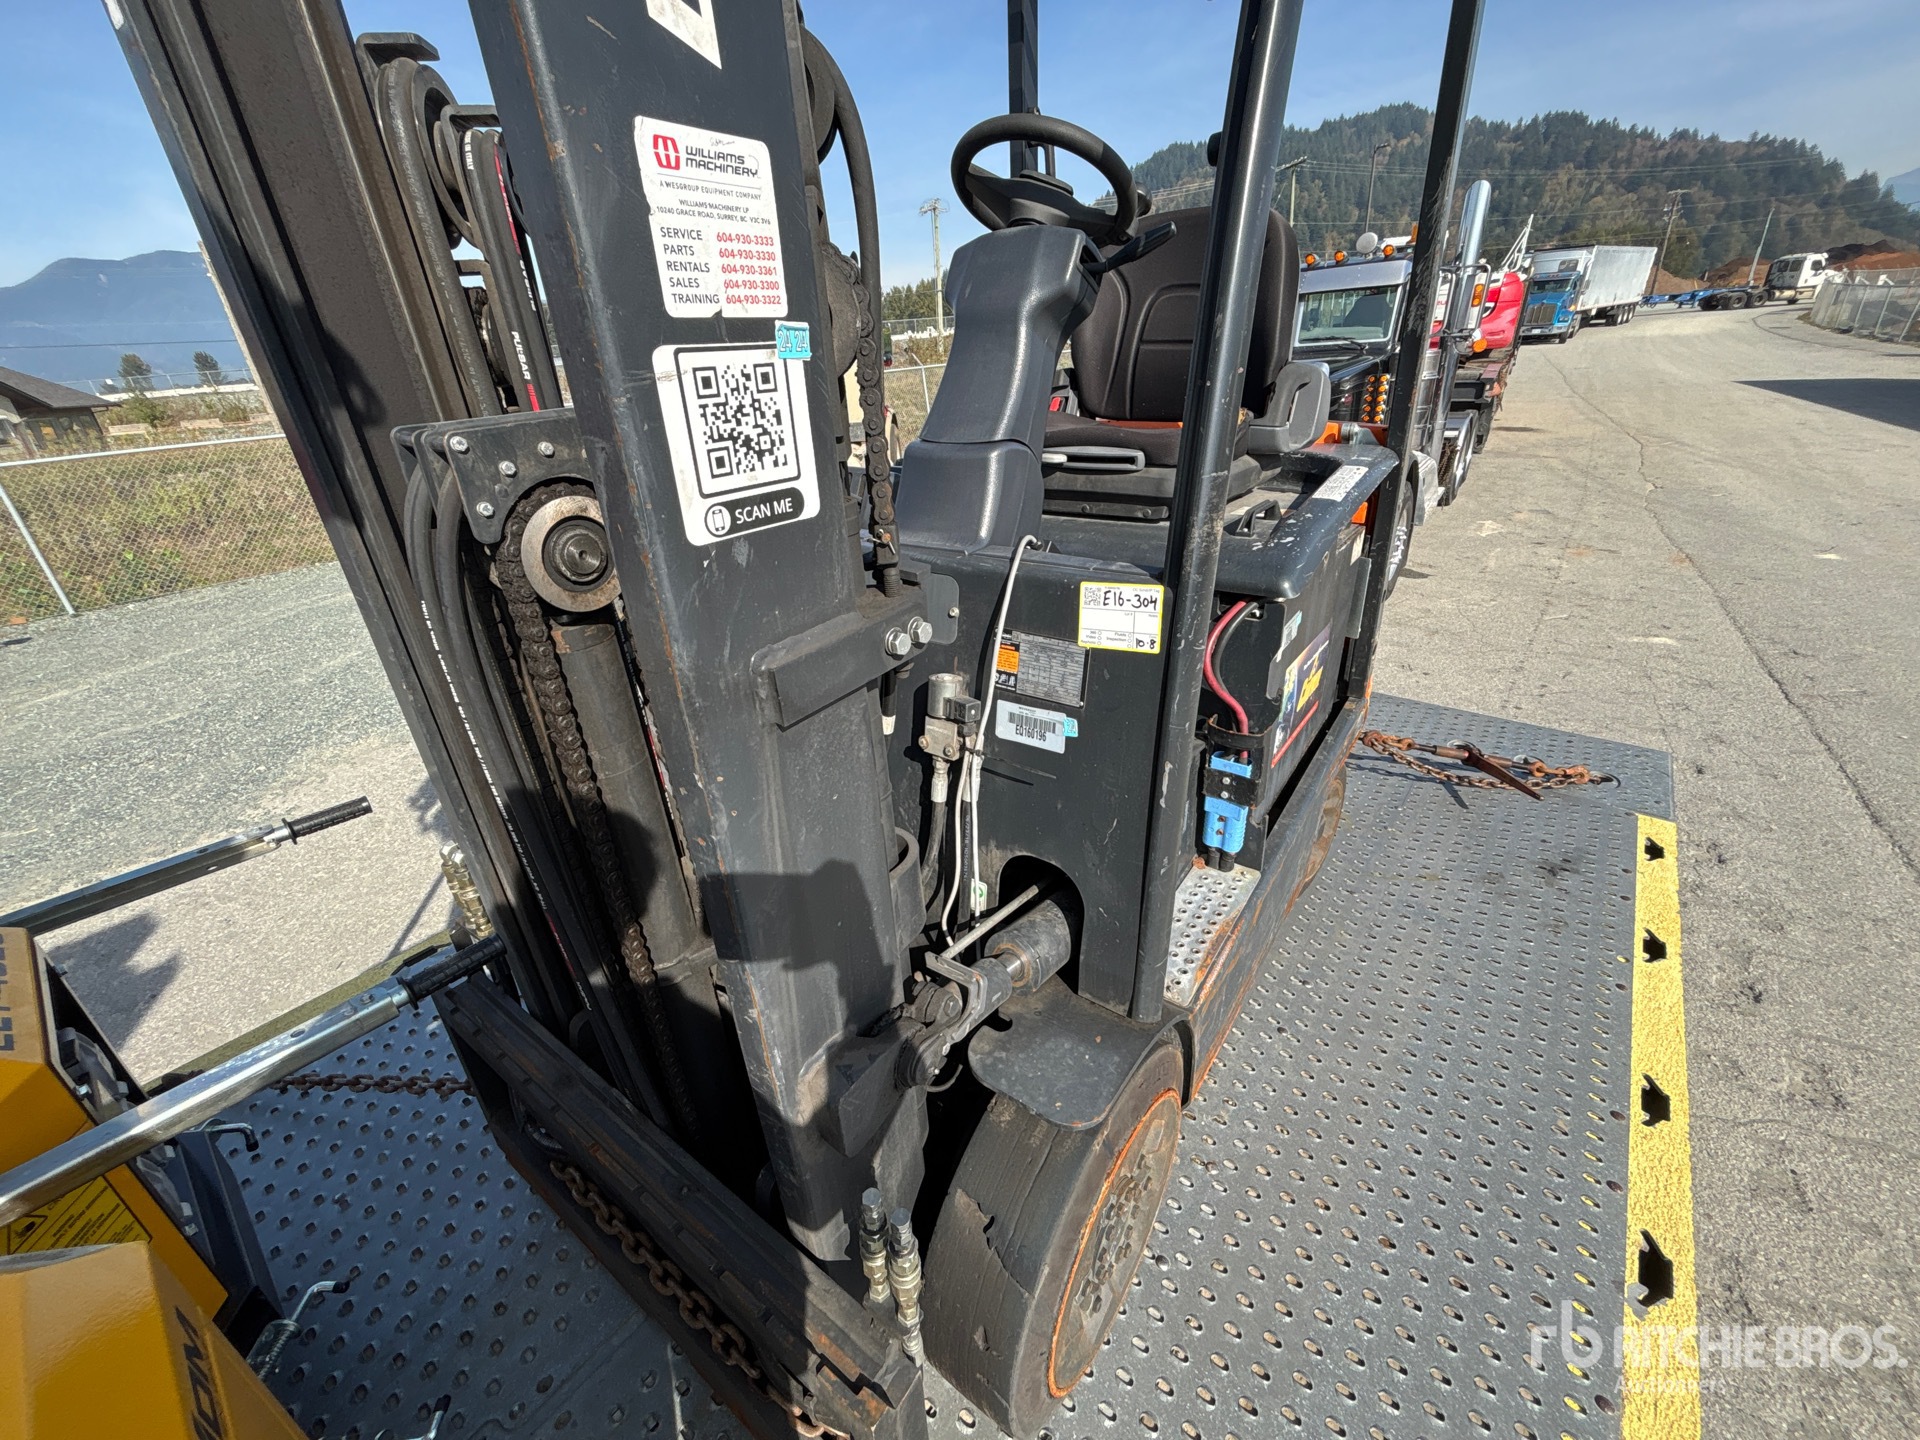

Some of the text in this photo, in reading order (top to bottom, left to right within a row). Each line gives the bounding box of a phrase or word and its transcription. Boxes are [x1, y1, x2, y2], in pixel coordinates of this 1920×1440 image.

[465, 152, 474, 170] ITALY
[685, 145, 745, 165] WILLIAMS
[685, 157, 758, 178] MACHINERY
[665, 180, 699, 192] WESGROUP
[701, 186, 734, 198] EQUIPMENT
[735, 191, 761, 201] COMPANY
[656, 206, 675, 215] 10240
[675, 208, 696, 217] GRACE
[697, 211, 715, 220] ROAD,
[716, 213, 739, 223] SURREY,
[678, 198, 708, 209] WILLIAMS
[708, 202, 741, 213] MACHINERY
[660, 226, 774, 247] SERVICE 604-930-3333
[663, 243, 776, 262] PARTS 604-930-3330
[666, 260, 777, 276] RENTALS 604-930-3361
[669, 276, 780, 291] SALES 604-930-3300
[671, 293, 782, 305] TRAINING 604-930-3322
[511, 331, 531, 380] PULSAR
[735, 497, 793, 525] SCAN ME
[1102, 590, 1158, 611] E16-304
[1015, 724, 1047, 742] EQ160196
